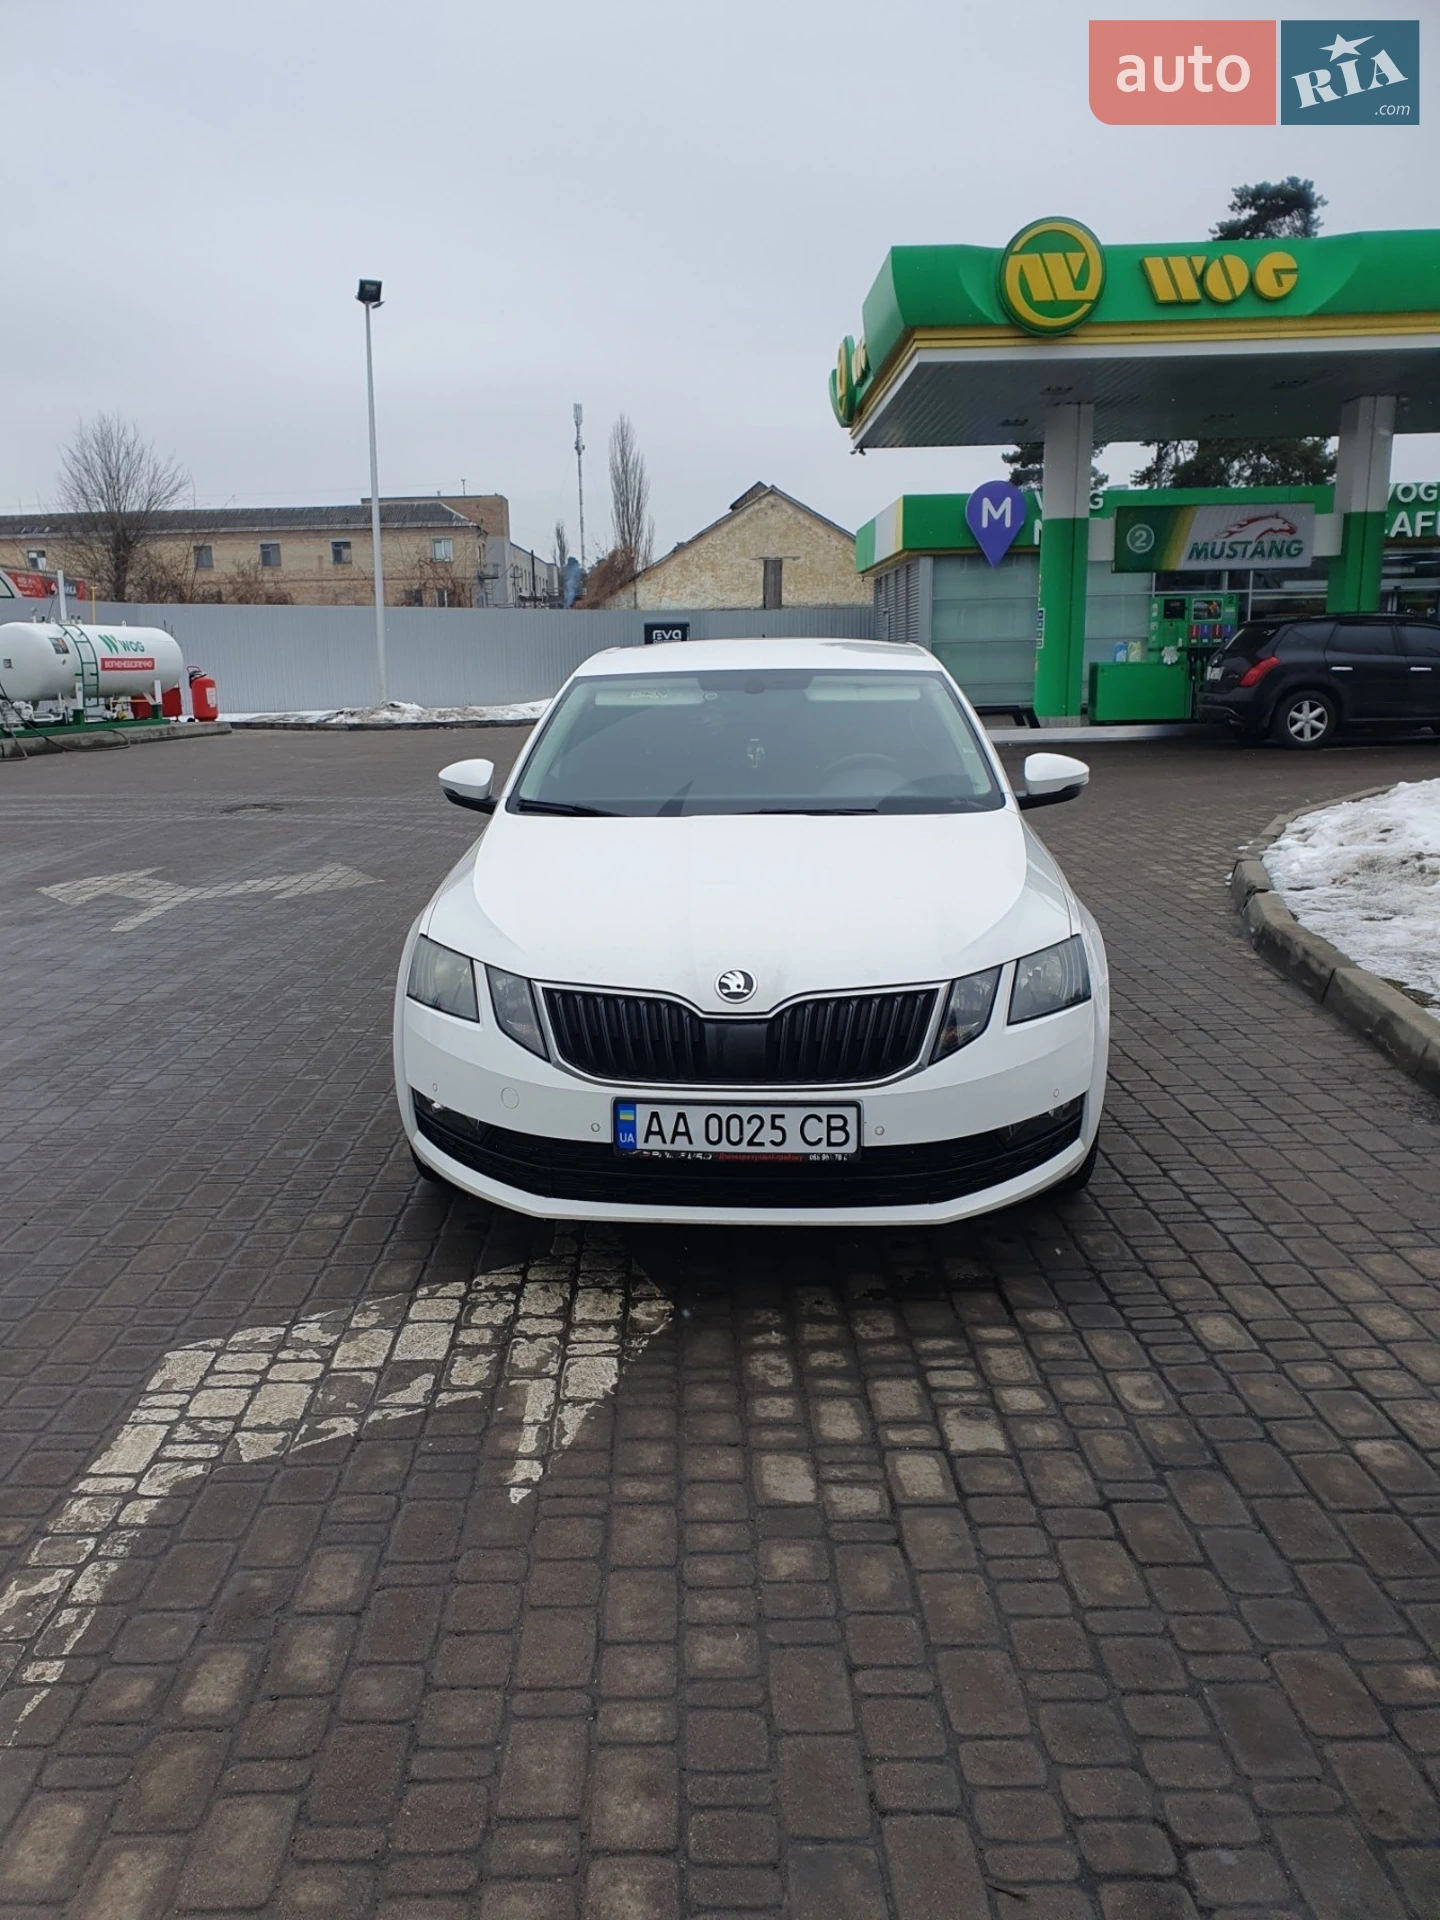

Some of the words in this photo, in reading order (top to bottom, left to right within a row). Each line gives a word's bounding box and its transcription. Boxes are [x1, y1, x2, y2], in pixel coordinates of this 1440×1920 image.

[1142, 250, 1299, 304] WOG
[981, 496, 1012, 529] M
[1133, 529, 1148, 548] 2
[1187, 539, 1305, 561] MUSTANG
[118, 639, 146, 653] WOG
[619, 1132, 635, 1144] UA
[643, 1111, 694, 1145] AA
[704, 1112, 788, 1148] 0025
[799, 1113, 851, 1148] CB
